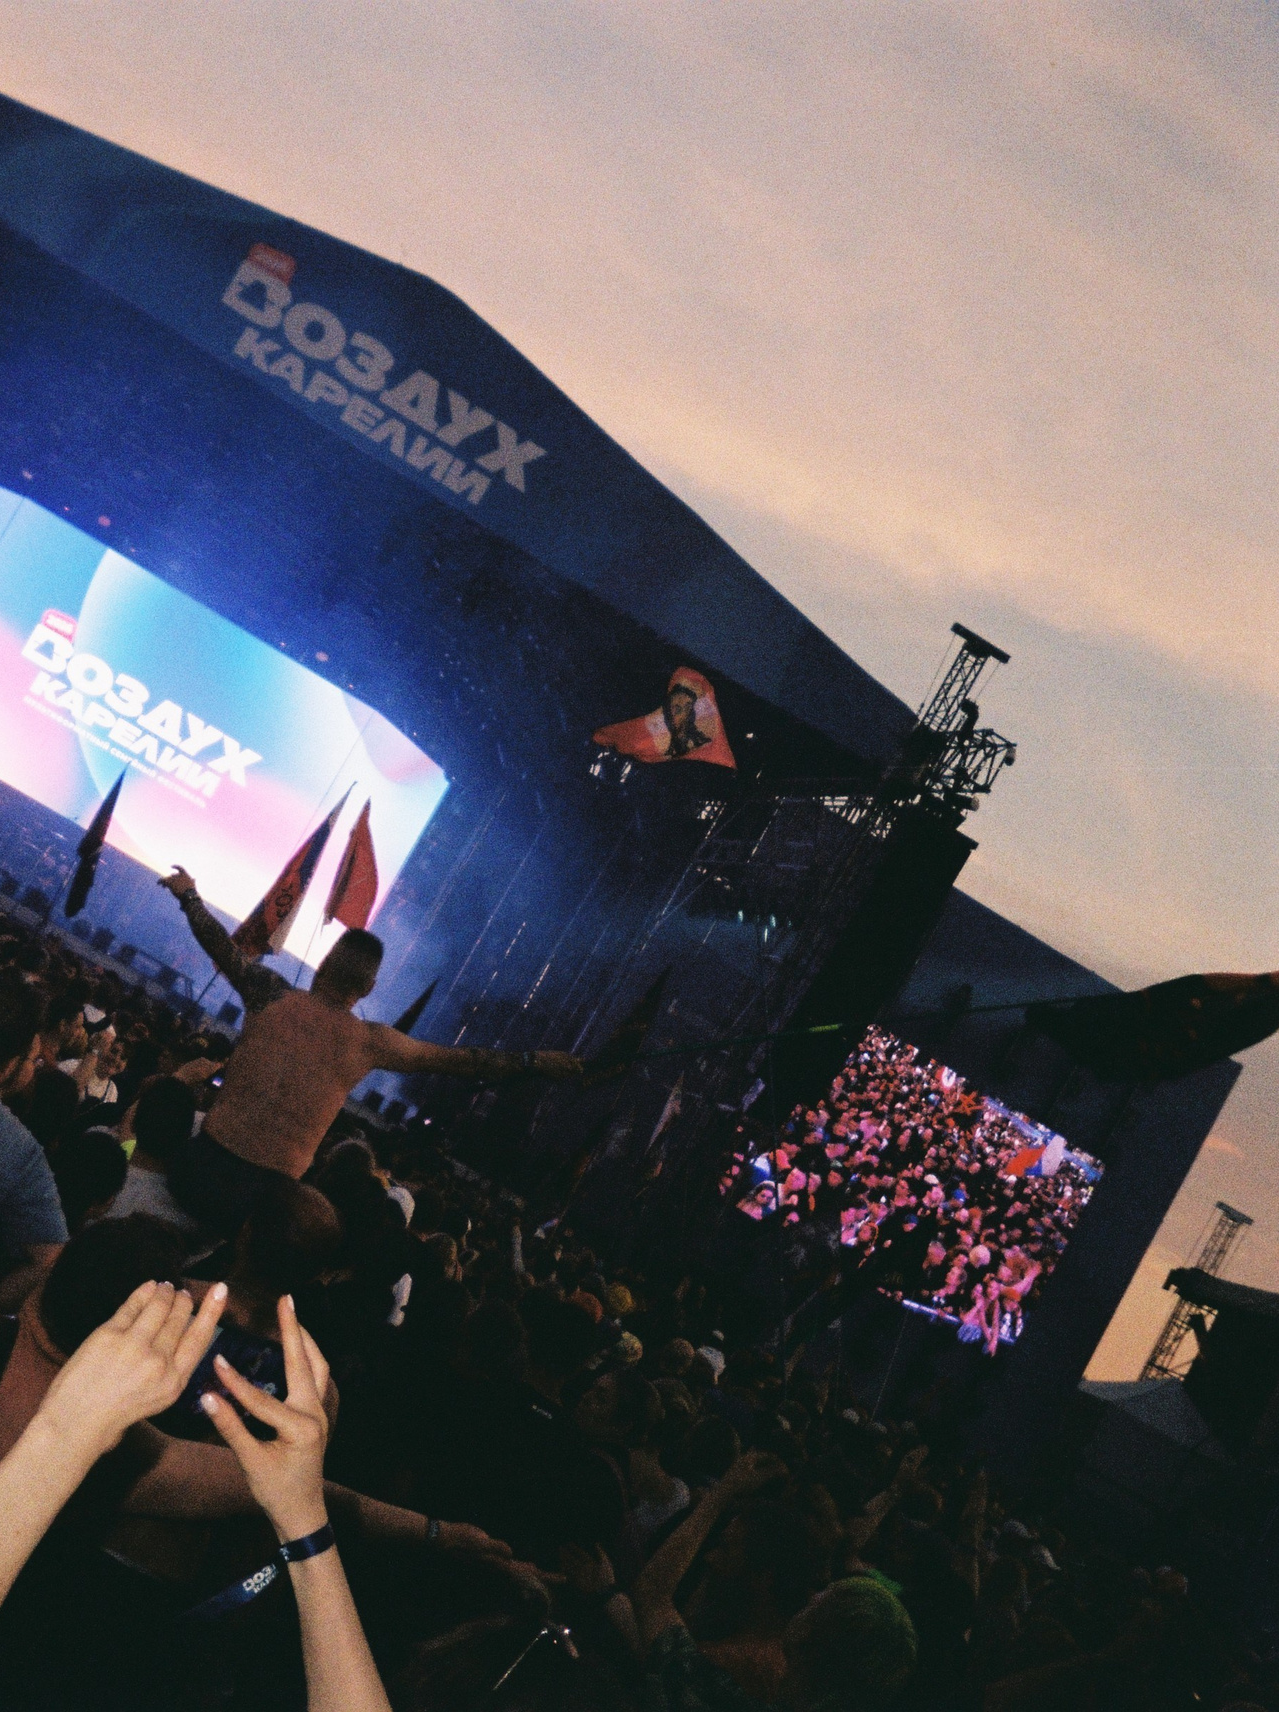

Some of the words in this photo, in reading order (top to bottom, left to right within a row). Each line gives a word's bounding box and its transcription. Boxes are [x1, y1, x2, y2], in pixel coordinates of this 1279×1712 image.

[222, 243, 547, 492] ВОЗДУХ
[233, 328, 490, 505] КАРЕЛИИ
[21, 608, 263, 787] ВОЗДУХ
[29, 670, 220, 797] КАРЕЛИИ
